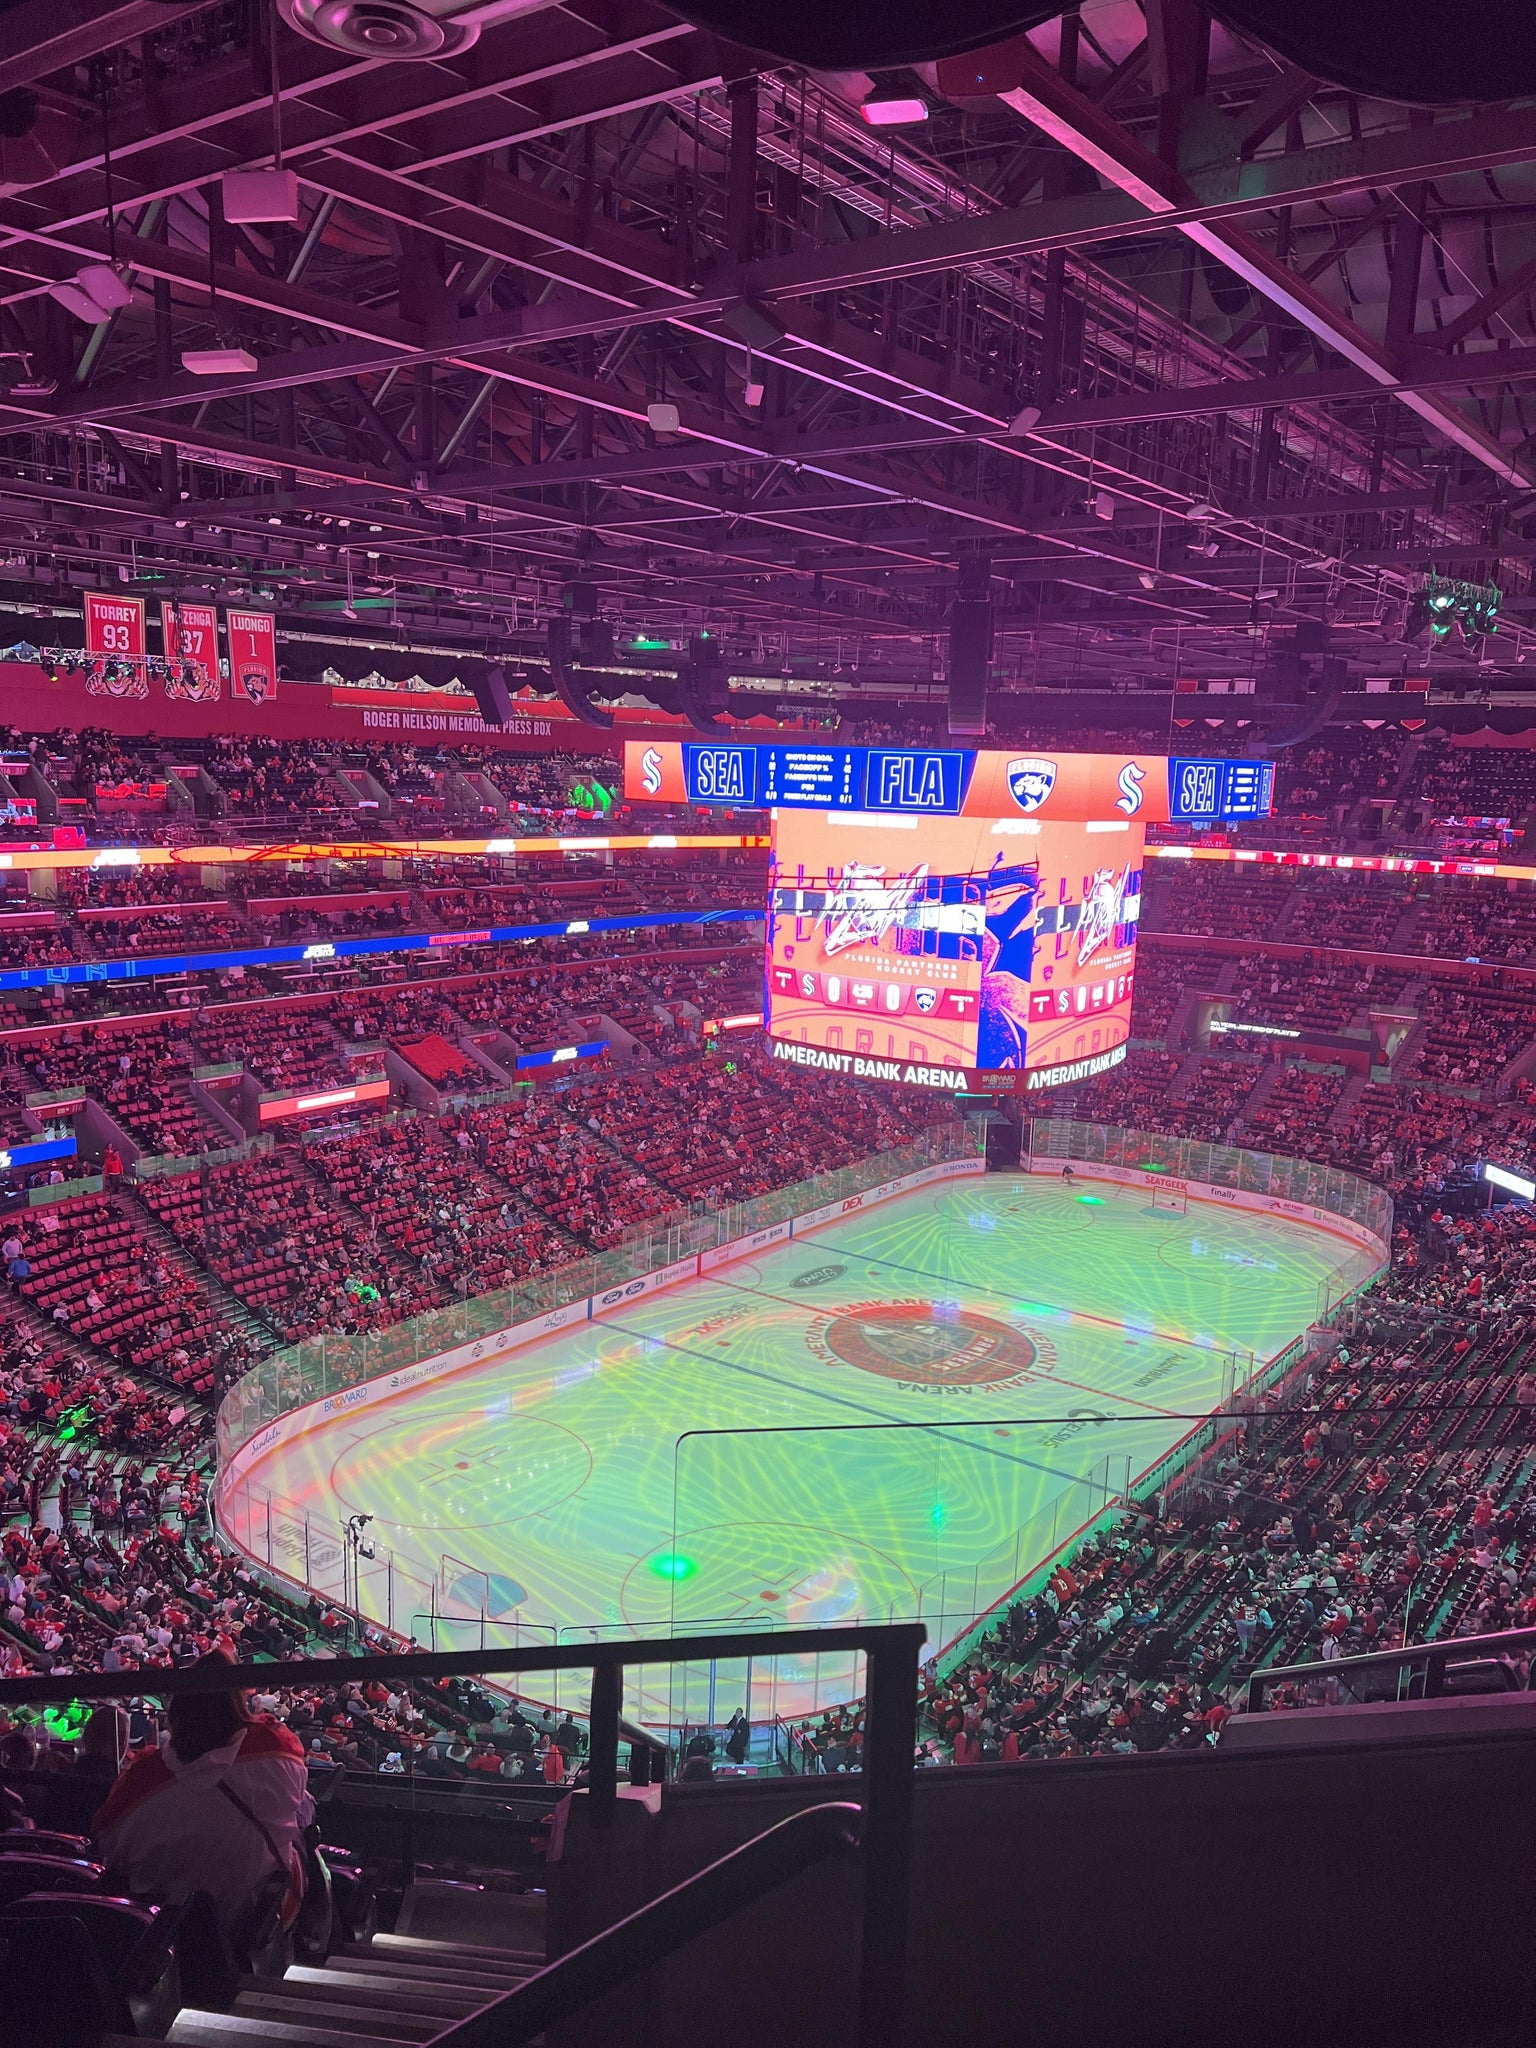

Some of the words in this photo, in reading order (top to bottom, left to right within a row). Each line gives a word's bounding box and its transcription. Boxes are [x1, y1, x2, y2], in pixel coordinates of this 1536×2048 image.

[93, 604, 137, 623] TORREY
[167, 609, 212, 627] HZENGA
[232, 616, 270, 633] LUONGO
[103, 624, 130, 650] 93
[181, 630, 204, 654] 37
[249, 634, 258, 657] 1
[363, 711, 400, 729] ROGER
[402, 714, 447, 731] NEILSON
[449, 716, 501, 733] MEMORIAL
[503, 720, 532, 736] PRESS
[533, 722, 552, 736] BOX
[697, 750, 745, 797] SEA
[880, 756, 945, 806] FLA
[1181, 765, 1216, 813] SEA
[774, 1042, 852, 1073] AMERANT
[854, 1058, 901, 1081] BANK
[904, 1066, 968, 1090] ARENA
[1028, 1061, 1090, 1090] AMERANT
[1090, 1055, 1112, 1075] BANK
[949, 1162, 978, 1172] HONDA
[1145, 1174, 1188, 1191] SEATGEEK
[1211, 1187, 1236, 1200] finally
[841, 1193, 864, 1212] DEX
[804, 1314, 846, 1368] AMERANT
[833, 1298, 890, 1316] BANK
[891, 1298, 961, 1311] ARENA
[931, 1334, 997, 1373] PANTHERS
[1007, 1320, 1059, 1373] AMERANT
[896, 1381, 974, 1396] ARENA
[983, 1374, 1037, 1394] BANK
[324, 1387, 368, 1412] BROWARD
[251, 1427, 281, 1456] Sandals
[1044, 1418, 1089, 1449] CELSIUS
